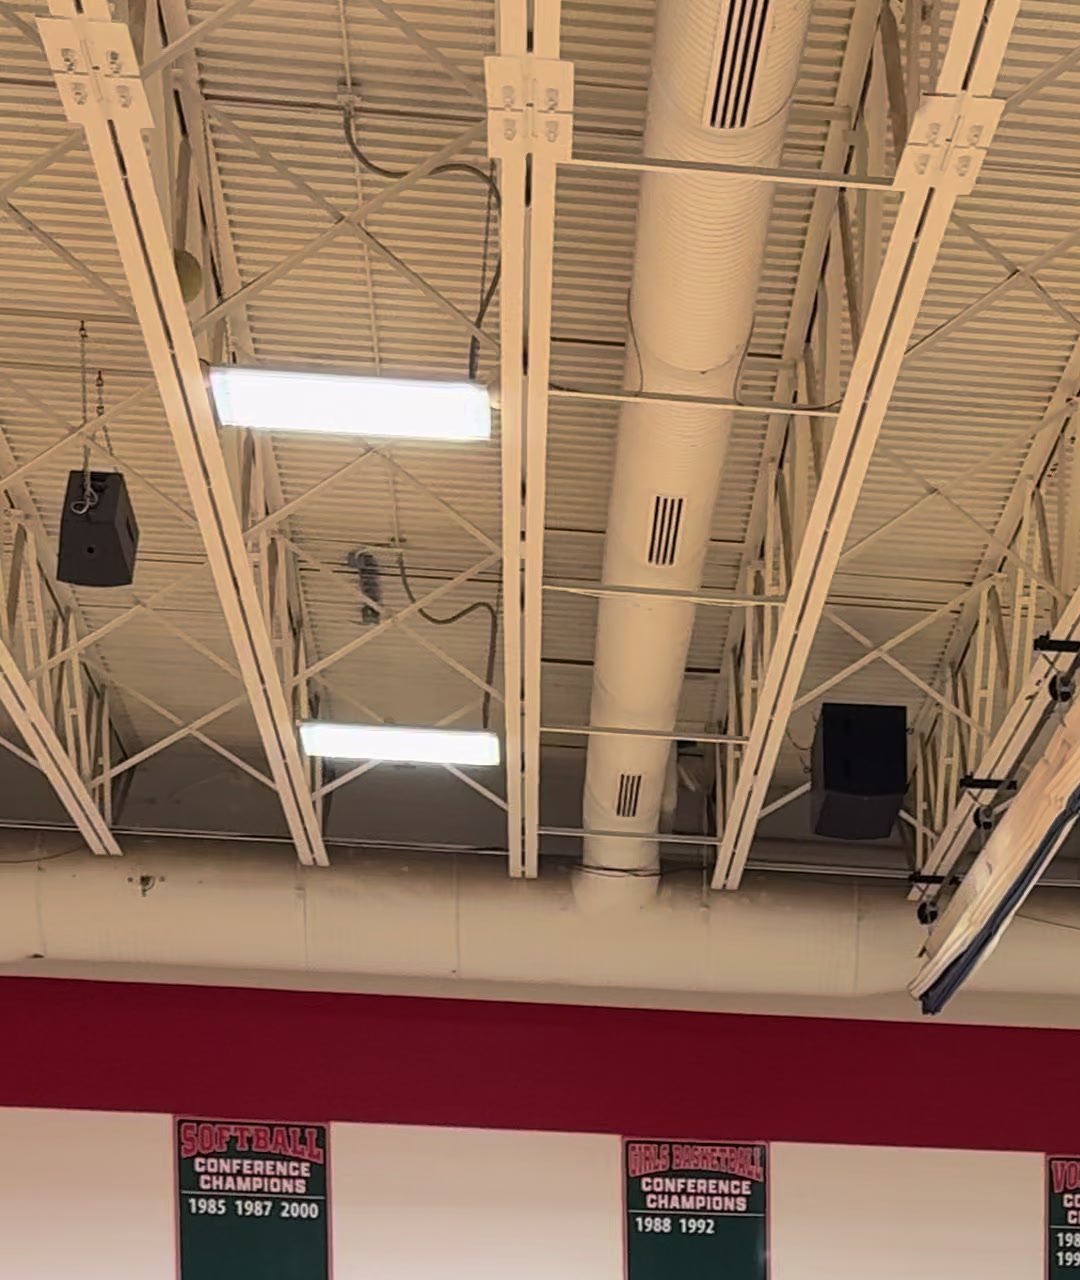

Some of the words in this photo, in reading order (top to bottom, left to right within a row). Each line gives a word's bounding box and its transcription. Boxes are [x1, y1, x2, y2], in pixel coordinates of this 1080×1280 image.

[181, 1122, 324, 1164] SOFTBALL
[194, 1157, 311, 1177] CONFERENCE
[672, 1144, 764, 1182] BASKETBALL
[199, 1174, 307, 1194] CHAMPIONS
[641, 1176, 752, 1195] CONFERENCE
[188, 1198, 226, 1215] 1985
[235, 1200, 272, 1217] 1987
[280, 1202, 319, 1219] 2000
[645, 1193, 748, 1212] CHAMPIONS
[635, 1217, 672, 1233] 1988
[679, 1218, 716, 1234] 1992
